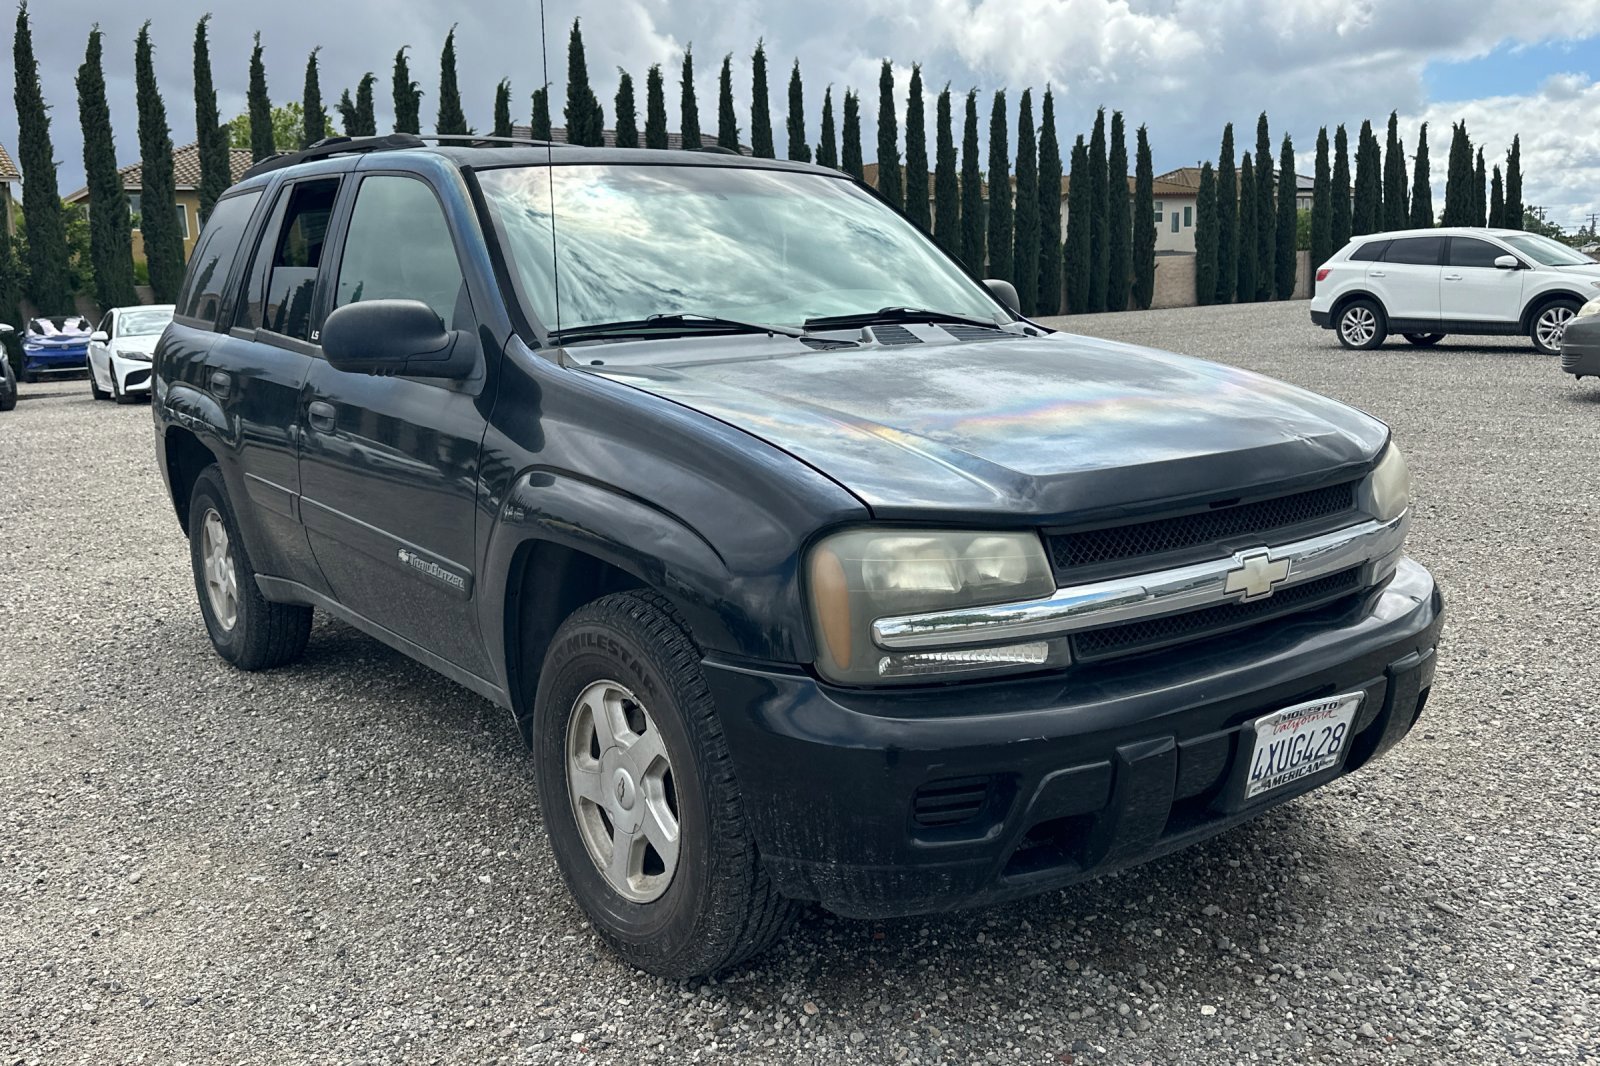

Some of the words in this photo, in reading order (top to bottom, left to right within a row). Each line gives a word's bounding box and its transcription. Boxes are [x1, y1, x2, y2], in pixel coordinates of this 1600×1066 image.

[311, 330, 320, 340] LS
[566, 632, 658, 699] MILESTAR
[1281, 701, 1338, 721] MODESTO
[1250, 722, 1347, 782] 4XUG428
[1262, 760, 1322, 790] AMERICAN
